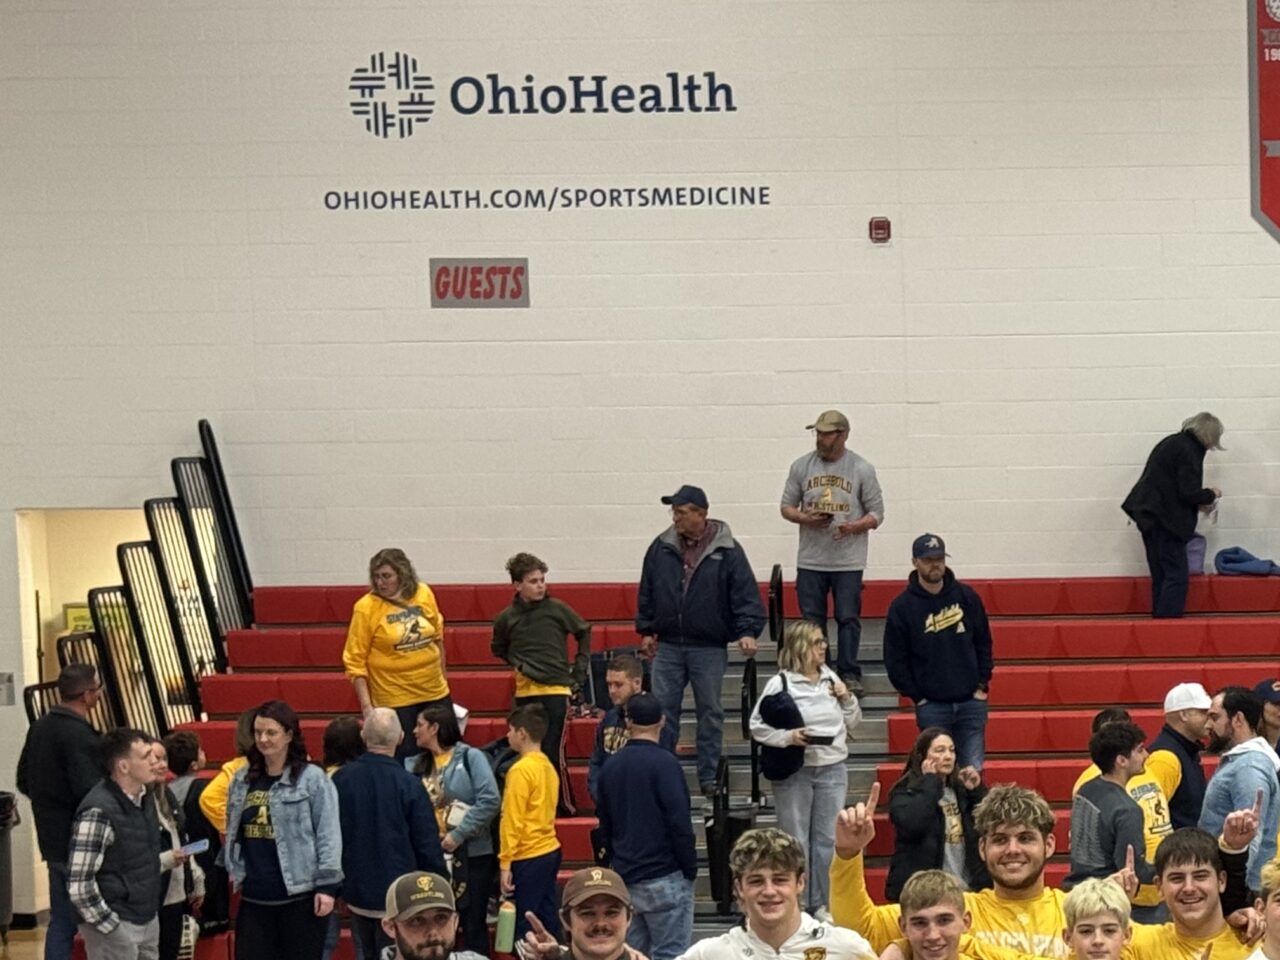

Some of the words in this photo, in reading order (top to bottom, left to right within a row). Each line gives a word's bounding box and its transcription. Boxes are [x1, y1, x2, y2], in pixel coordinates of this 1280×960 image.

[450, 72, 738, 115] OhioHealth
[324, 186, 771, 212] OHIOHEALTH.COM/SPORTSMEDICINE
[435, 265, 526, 300] GUESTS
